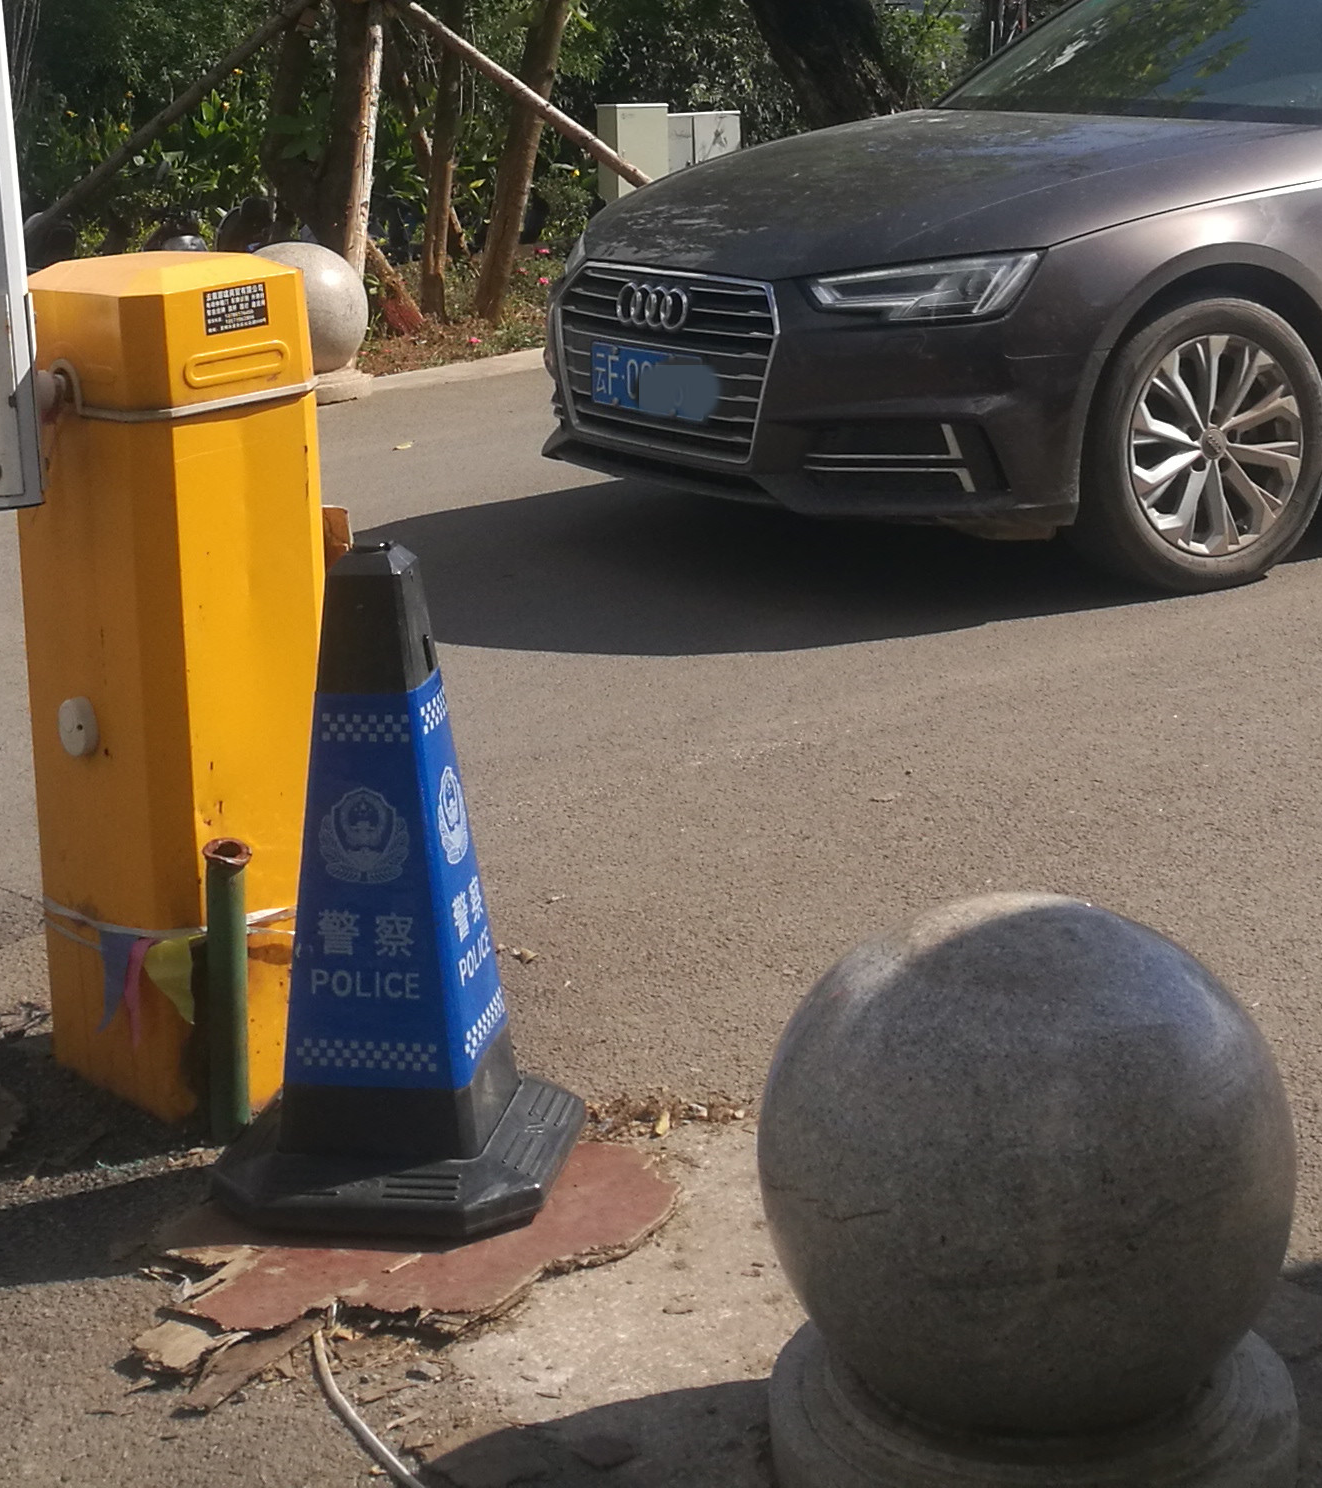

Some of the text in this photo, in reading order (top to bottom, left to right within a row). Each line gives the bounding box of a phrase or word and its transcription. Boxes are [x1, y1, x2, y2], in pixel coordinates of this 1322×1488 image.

[317, 909, 415, 958] 警察
[451, 875, 484, 943] 警察
[310, 968, 421, 1000] POLICE
[457, 924, 492, 988] POLICE
